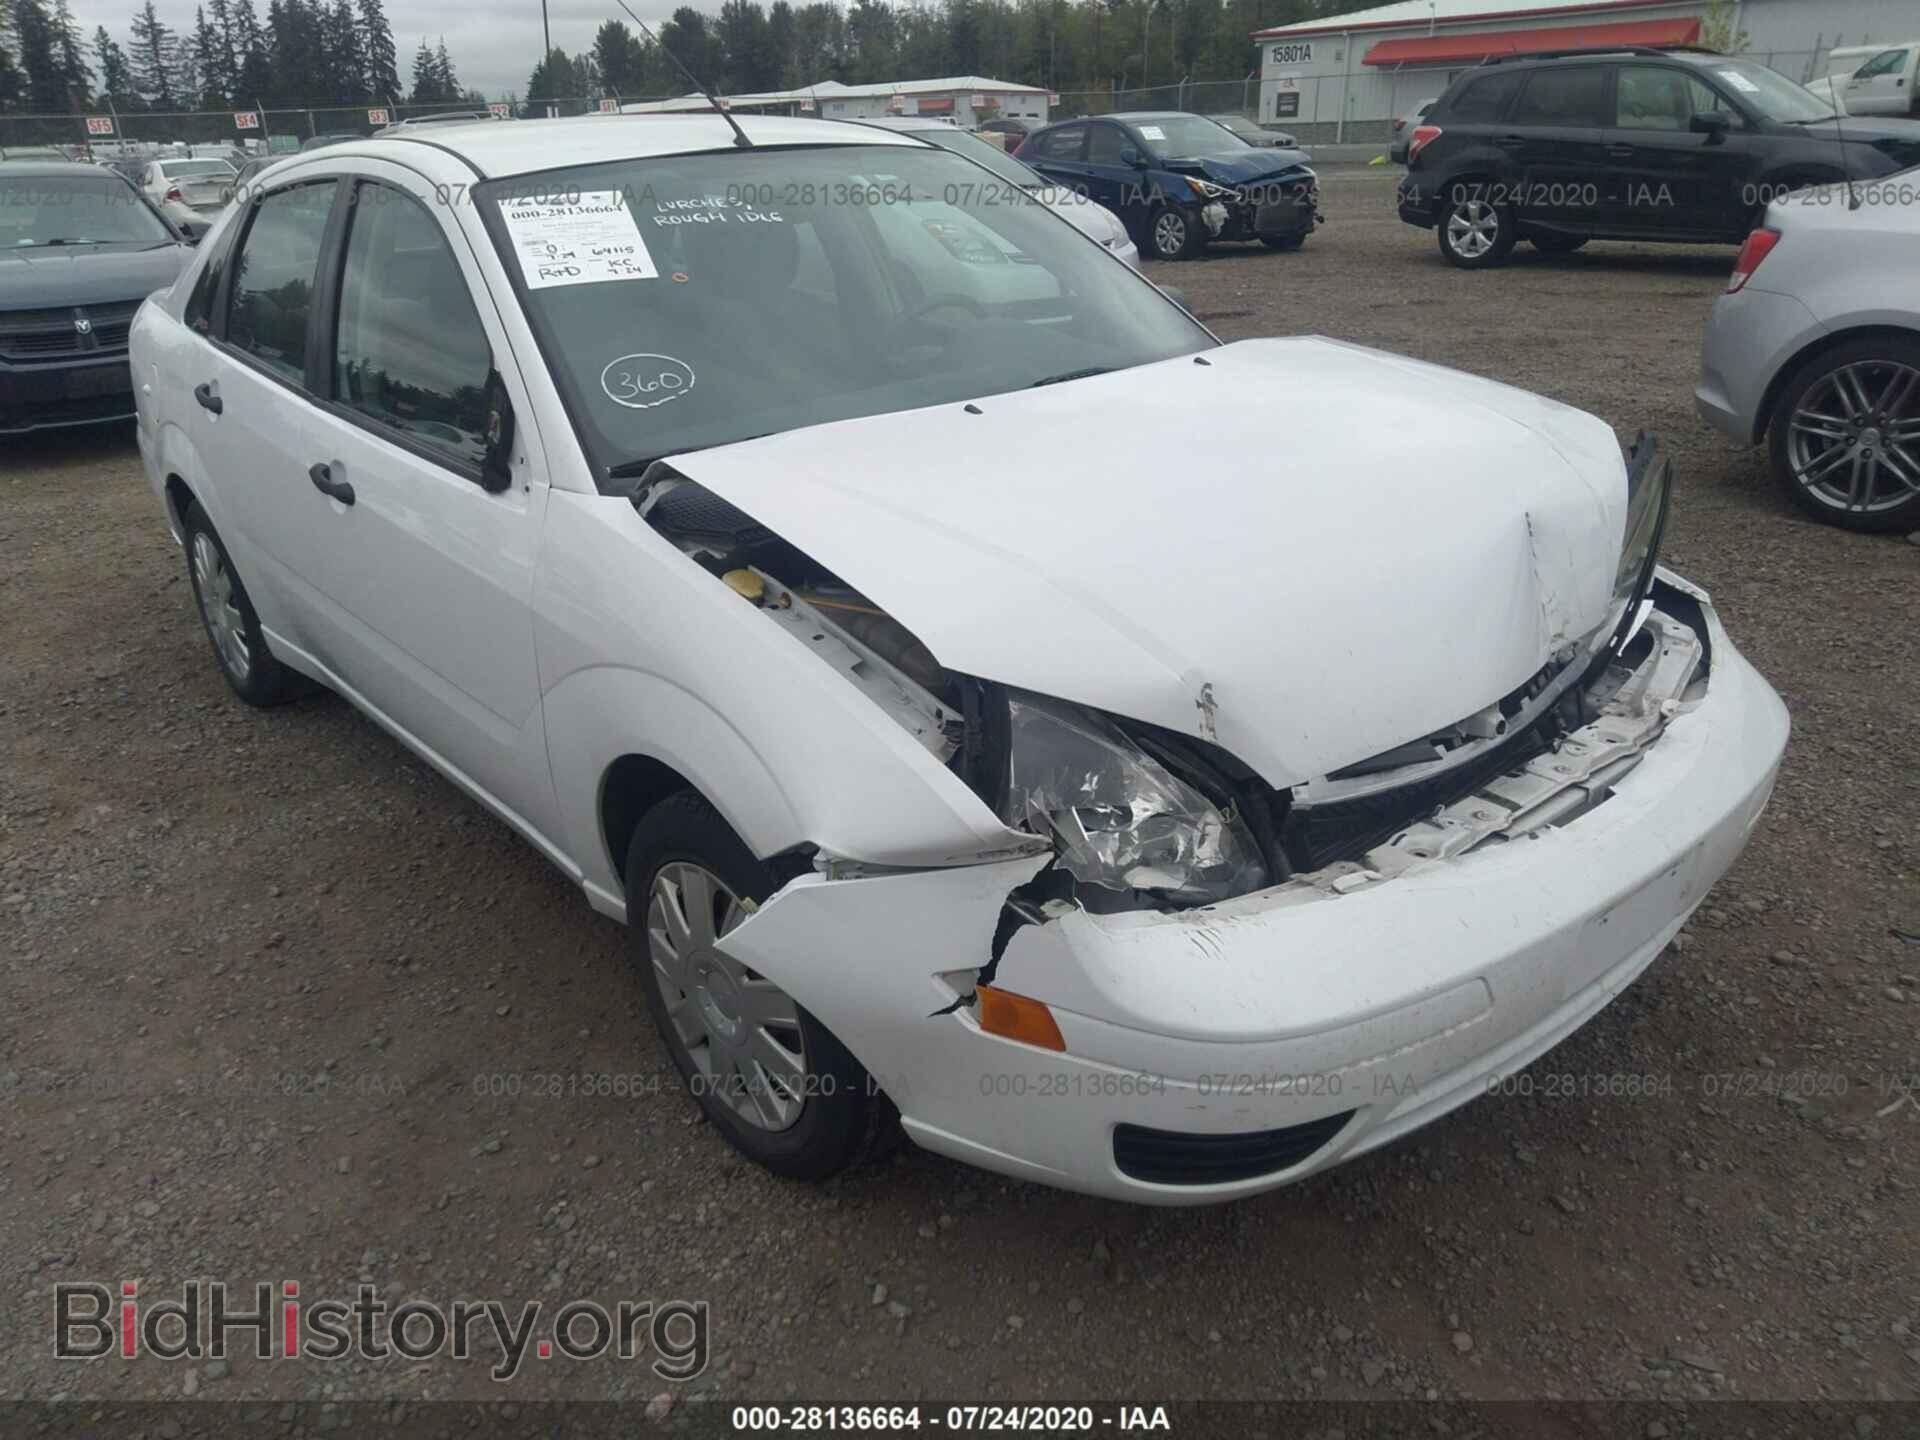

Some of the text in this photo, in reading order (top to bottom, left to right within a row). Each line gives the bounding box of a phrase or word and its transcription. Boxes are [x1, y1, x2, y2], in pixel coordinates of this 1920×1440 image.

[1272, 44, 1312, 63] 15801A
[88, 119, 113, 133] SF5
[511, 203, 624, 220] 000-28136664
[653, 211, 727, 226] ROUGH
[616, 372, 683, 399] 360
